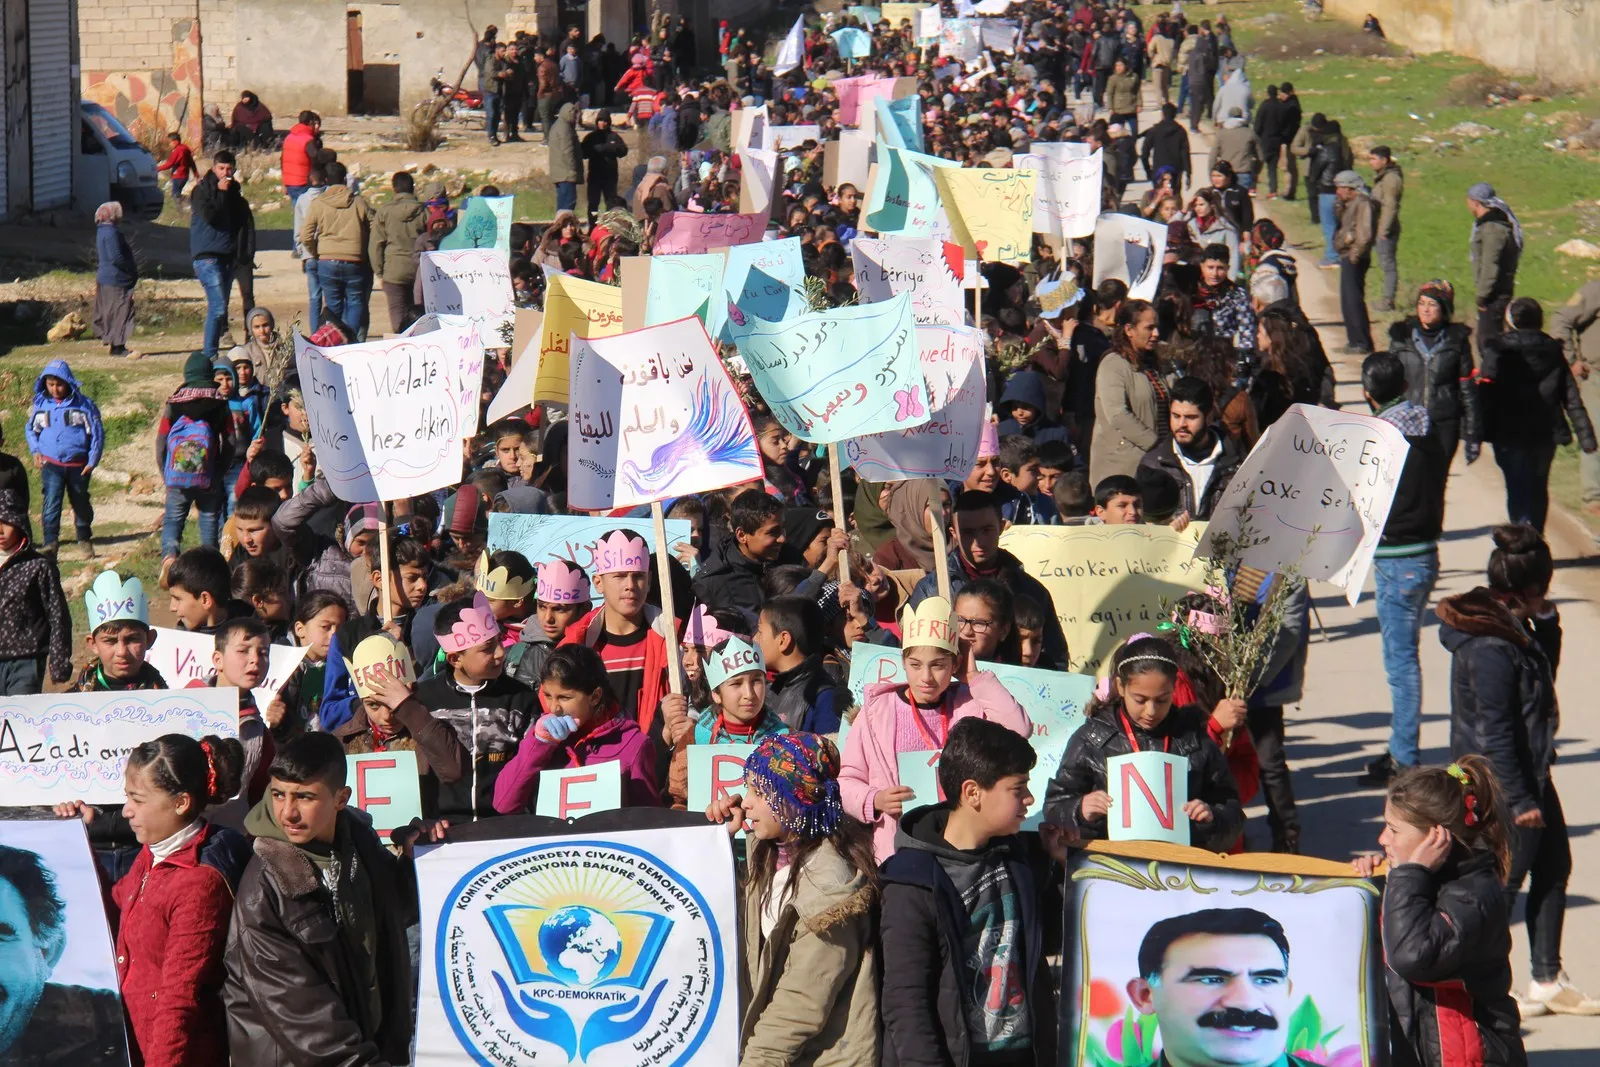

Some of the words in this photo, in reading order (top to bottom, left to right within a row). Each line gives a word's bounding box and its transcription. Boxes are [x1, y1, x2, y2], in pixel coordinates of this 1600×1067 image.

[371, 414, 406, 452] hez
[721, 649, 760, 674] RECO
[0, 718, 90, 764] Azadî
[1119, 762, 1174, 831] N
[492, 860, 579, 894] FEDERASIYONA
[582, 861, 636, 881] BAKURÊ
[498, 850, 581, 873] PERWERDEYA
[585, 850, 635, 866] CIVAKA
